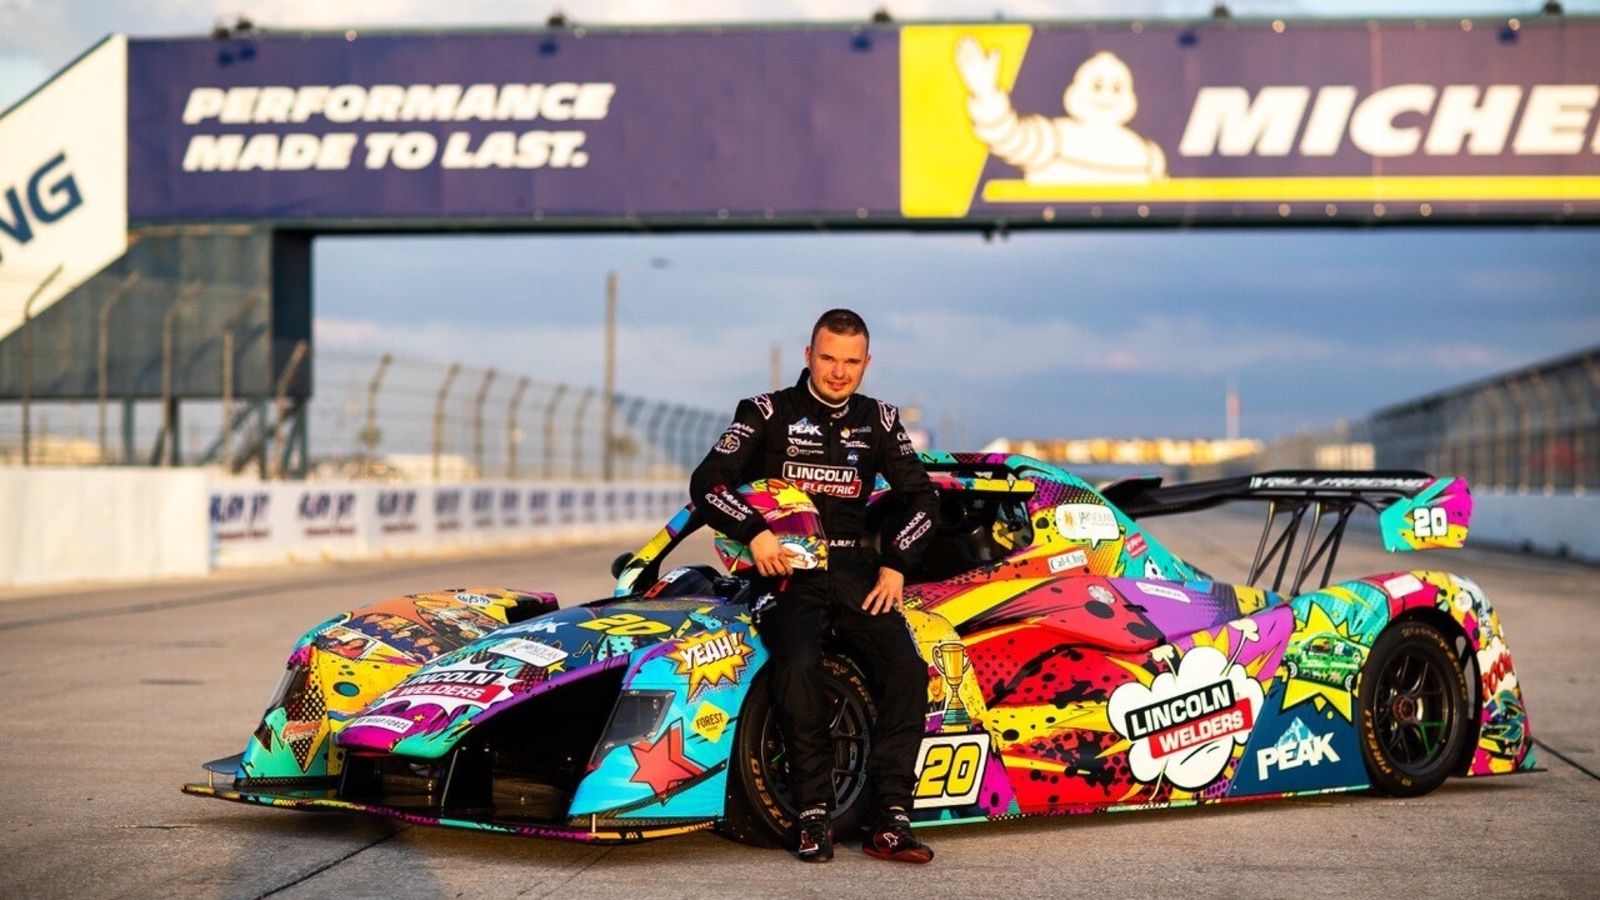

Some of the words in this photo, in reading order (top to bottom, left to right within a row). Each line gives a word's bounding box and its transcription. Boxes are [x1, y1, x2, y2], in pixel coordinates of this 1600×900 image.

[182, 82, 616, 125] PERFORMANCE
[1178, 84, 1600, 157] MICHE
[182, 134, 356, 172] MADE
[362, 133, 439, 170] TO
[440, 130, 590, 168] LAST.
[788, 424, 823, 436] PEAK
[786, 464, 855, 483] LINCOLN
[801, 482, 855, 496] ELECTRIC
[1413, 507, 1448, 538] 20
[1050, 553, 1086, 571] Cal-Chip
[576, 613, 672, 636] 20
[681, 632, 742, 670] YEAH!
[398, 684, 486, 700] WELDERS
[1130, 682, 1232, 737] LINCOLN
[696, 713, 723, 729] FOREST
[1159, 709, 1244, 753] WELDERS
[915, 742, 981, 798] 20
[1257, 731, 1340, 781] PEAK
[750, 757, 784, 819] ZERO
